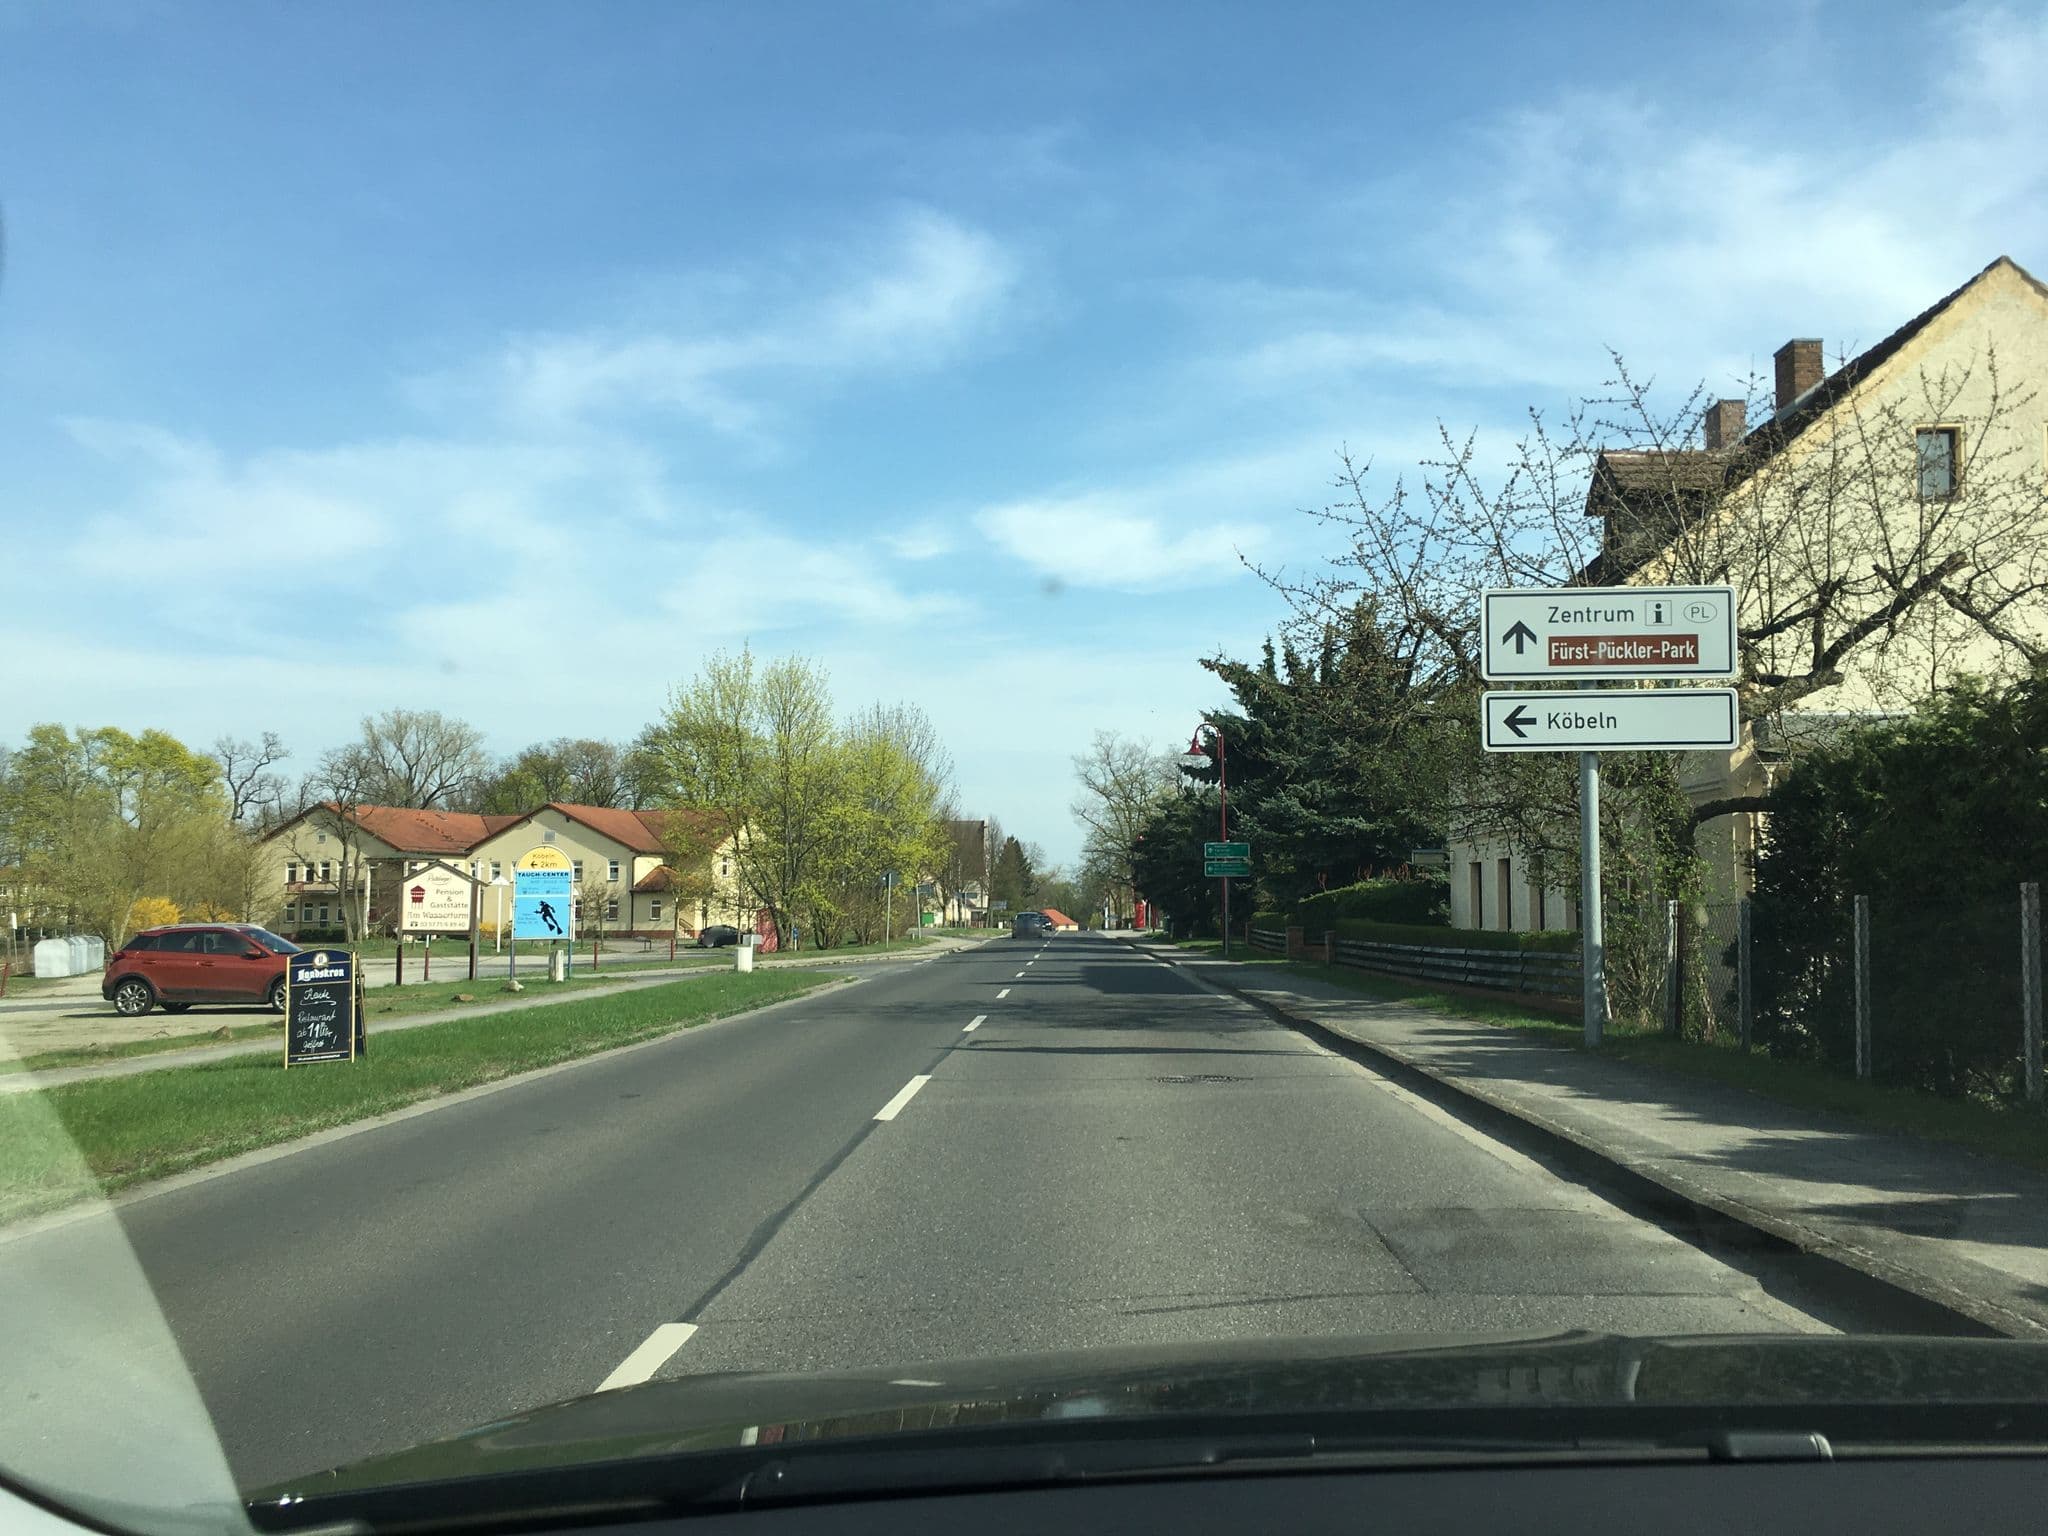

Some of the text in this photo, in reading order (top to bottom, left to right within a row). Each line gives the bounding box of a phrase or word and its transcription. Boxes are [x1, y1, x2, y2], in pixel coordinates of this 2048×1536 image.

[1548, 606, 1634, 623] Zentrum
[1690, 606, 1710, 619] PL
[1550, 640, 1696, 660] Fürst-Pückler-Park
[1547, 711, 1617, 729] Köbeln
[435, 888, 464, 896] Pension
[308, 1022, 320, 1038] 11
